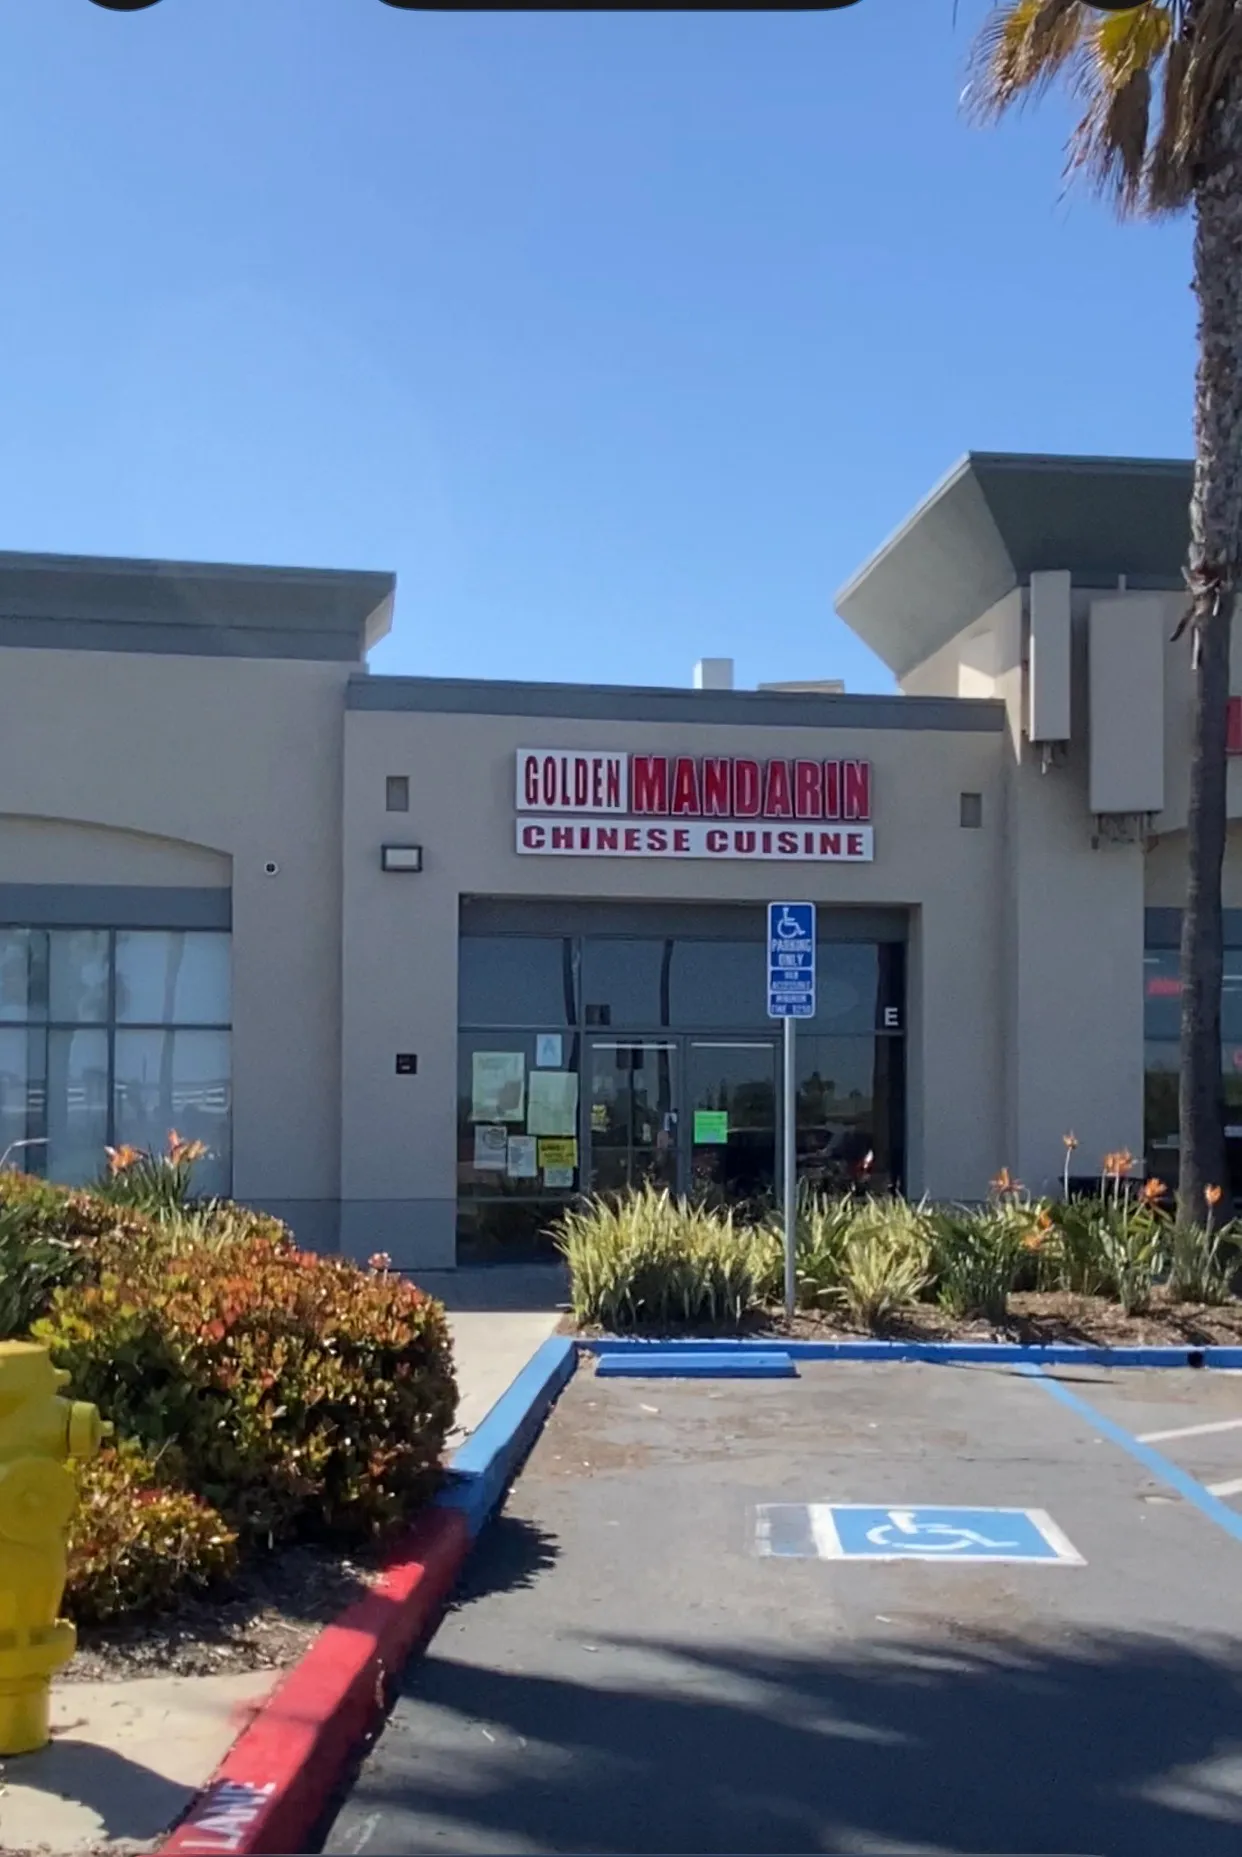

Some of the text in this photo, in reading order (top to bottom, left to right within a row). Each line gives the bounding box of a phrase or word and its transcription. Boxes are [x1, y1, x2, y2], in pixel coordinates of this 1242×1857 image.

[524, 753, 871, 820] GOLDEN MANDARIN
[522, 824, 865, 856] CHINESE CUISINE
[884, 1007, 899, 1026] E
[179, 1781, 277, 1850] LANE
